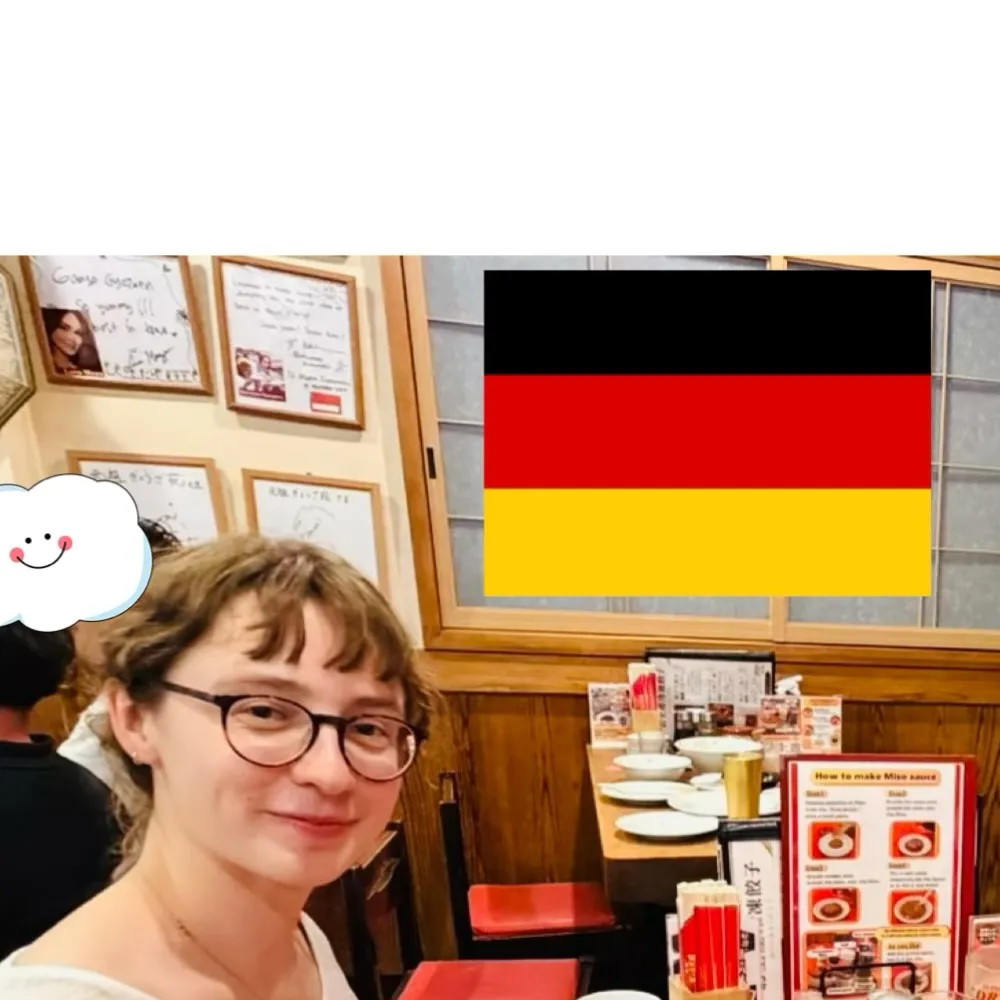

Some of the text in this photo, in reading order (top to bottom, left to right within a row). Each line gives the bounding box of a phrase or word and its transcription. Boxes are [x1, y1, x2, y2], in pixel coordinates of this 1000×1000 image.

[815, 772, 936, 781] How to make Miso sauce
